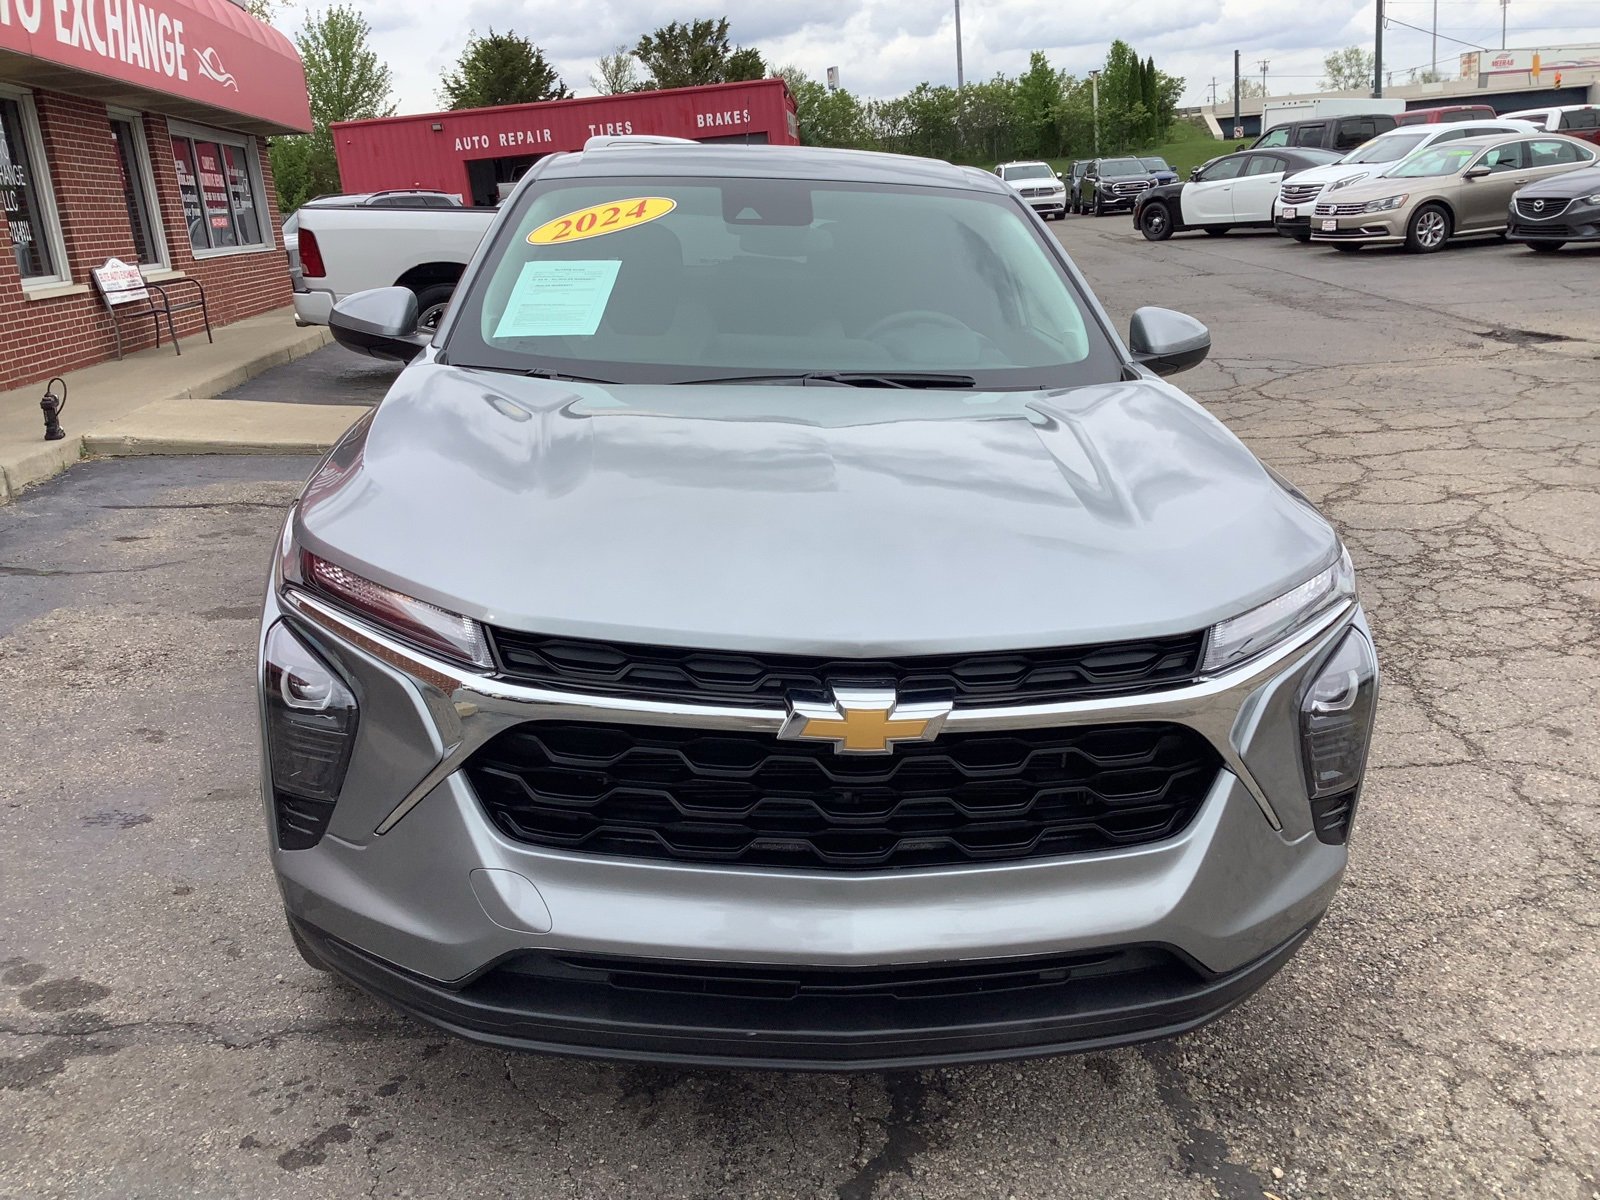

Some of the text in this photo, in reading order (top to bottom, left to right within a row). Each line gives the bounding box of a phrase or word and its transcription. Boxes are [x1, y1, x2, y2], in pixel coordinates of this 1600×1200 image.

[53, 0, 188, 82] EXCHANGE
[588, 121, 633, 137] TIRES
[696, 109, 751, 128] BRAKES
[455, 128, 552, 151] AUTO REPAIR
[2, 190, 19, 212] LLC
[551, 199, 648, 241] 2024
